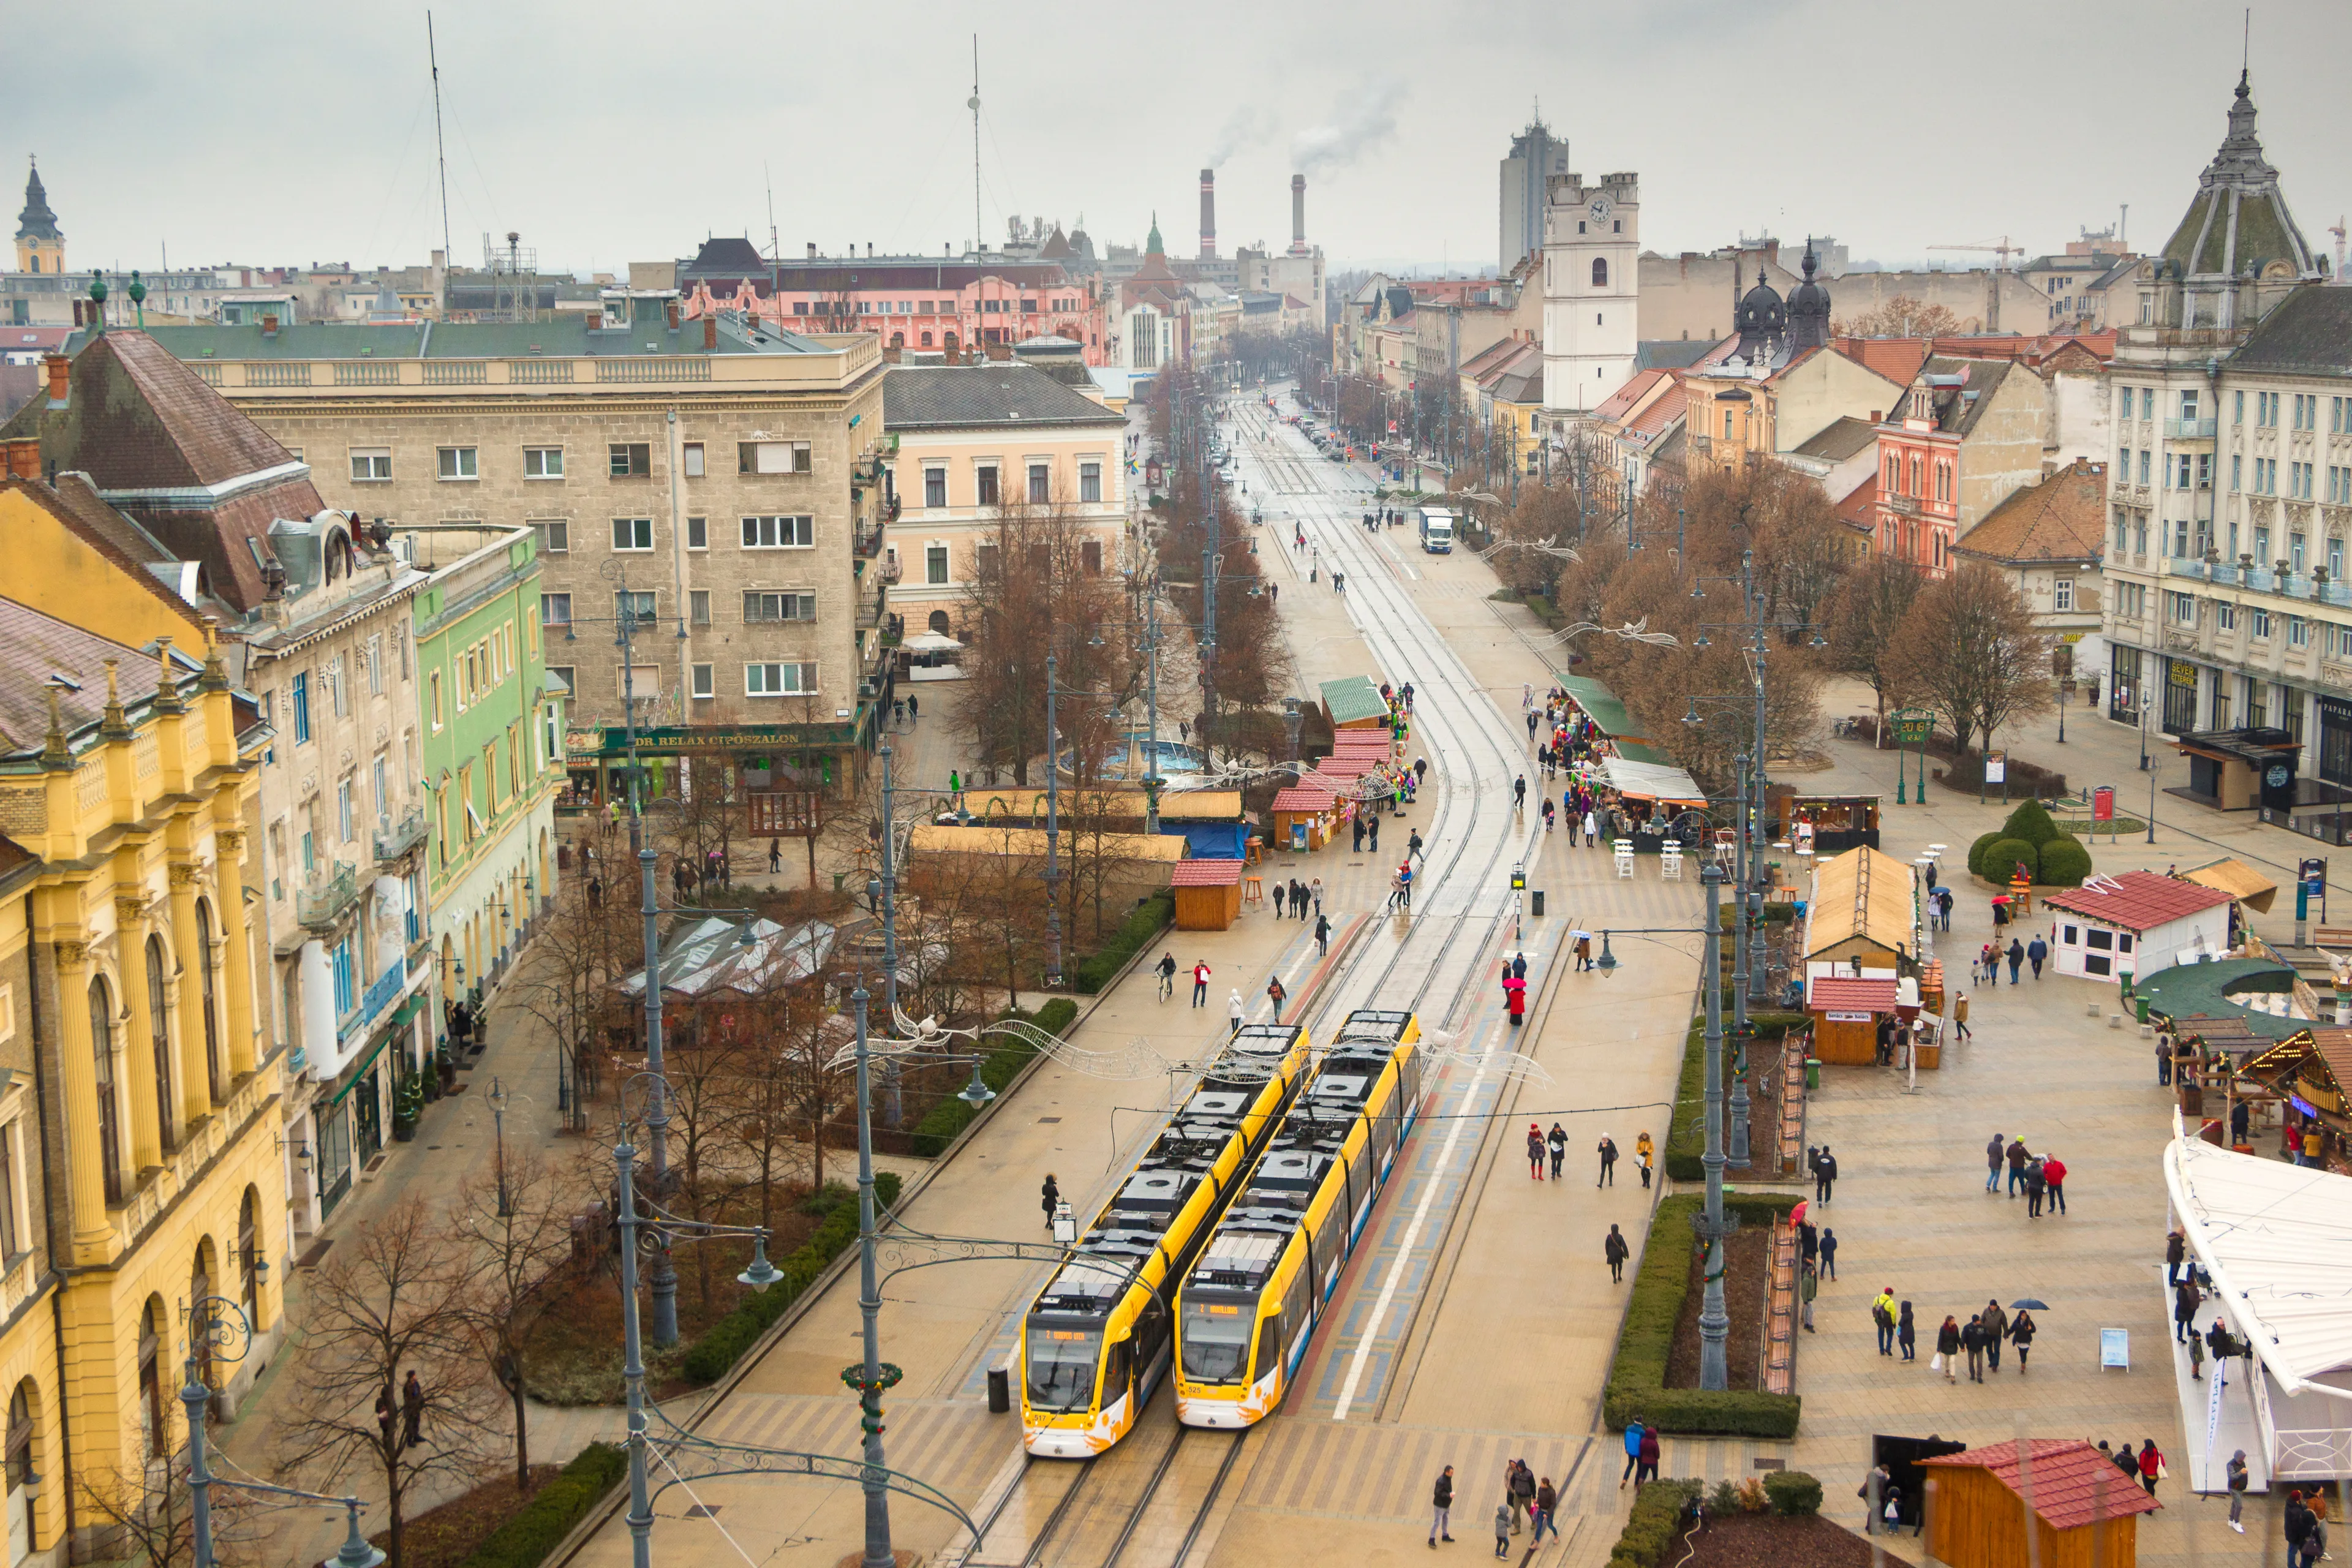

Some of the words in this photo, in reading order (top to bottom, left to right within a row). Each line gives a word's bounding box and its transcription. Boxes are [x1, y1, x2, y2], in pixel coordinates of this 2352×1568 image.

[2171, 662, 2194, 676] SEVER
[1901, 722, 1924, 732] 2018
[635, 738, 656, 747] DR.
[658, 737, 706, 746] RELAX
[1200, 1303, 1204, 1313] 2
[1046, 1330, 1050, 1339] 2
